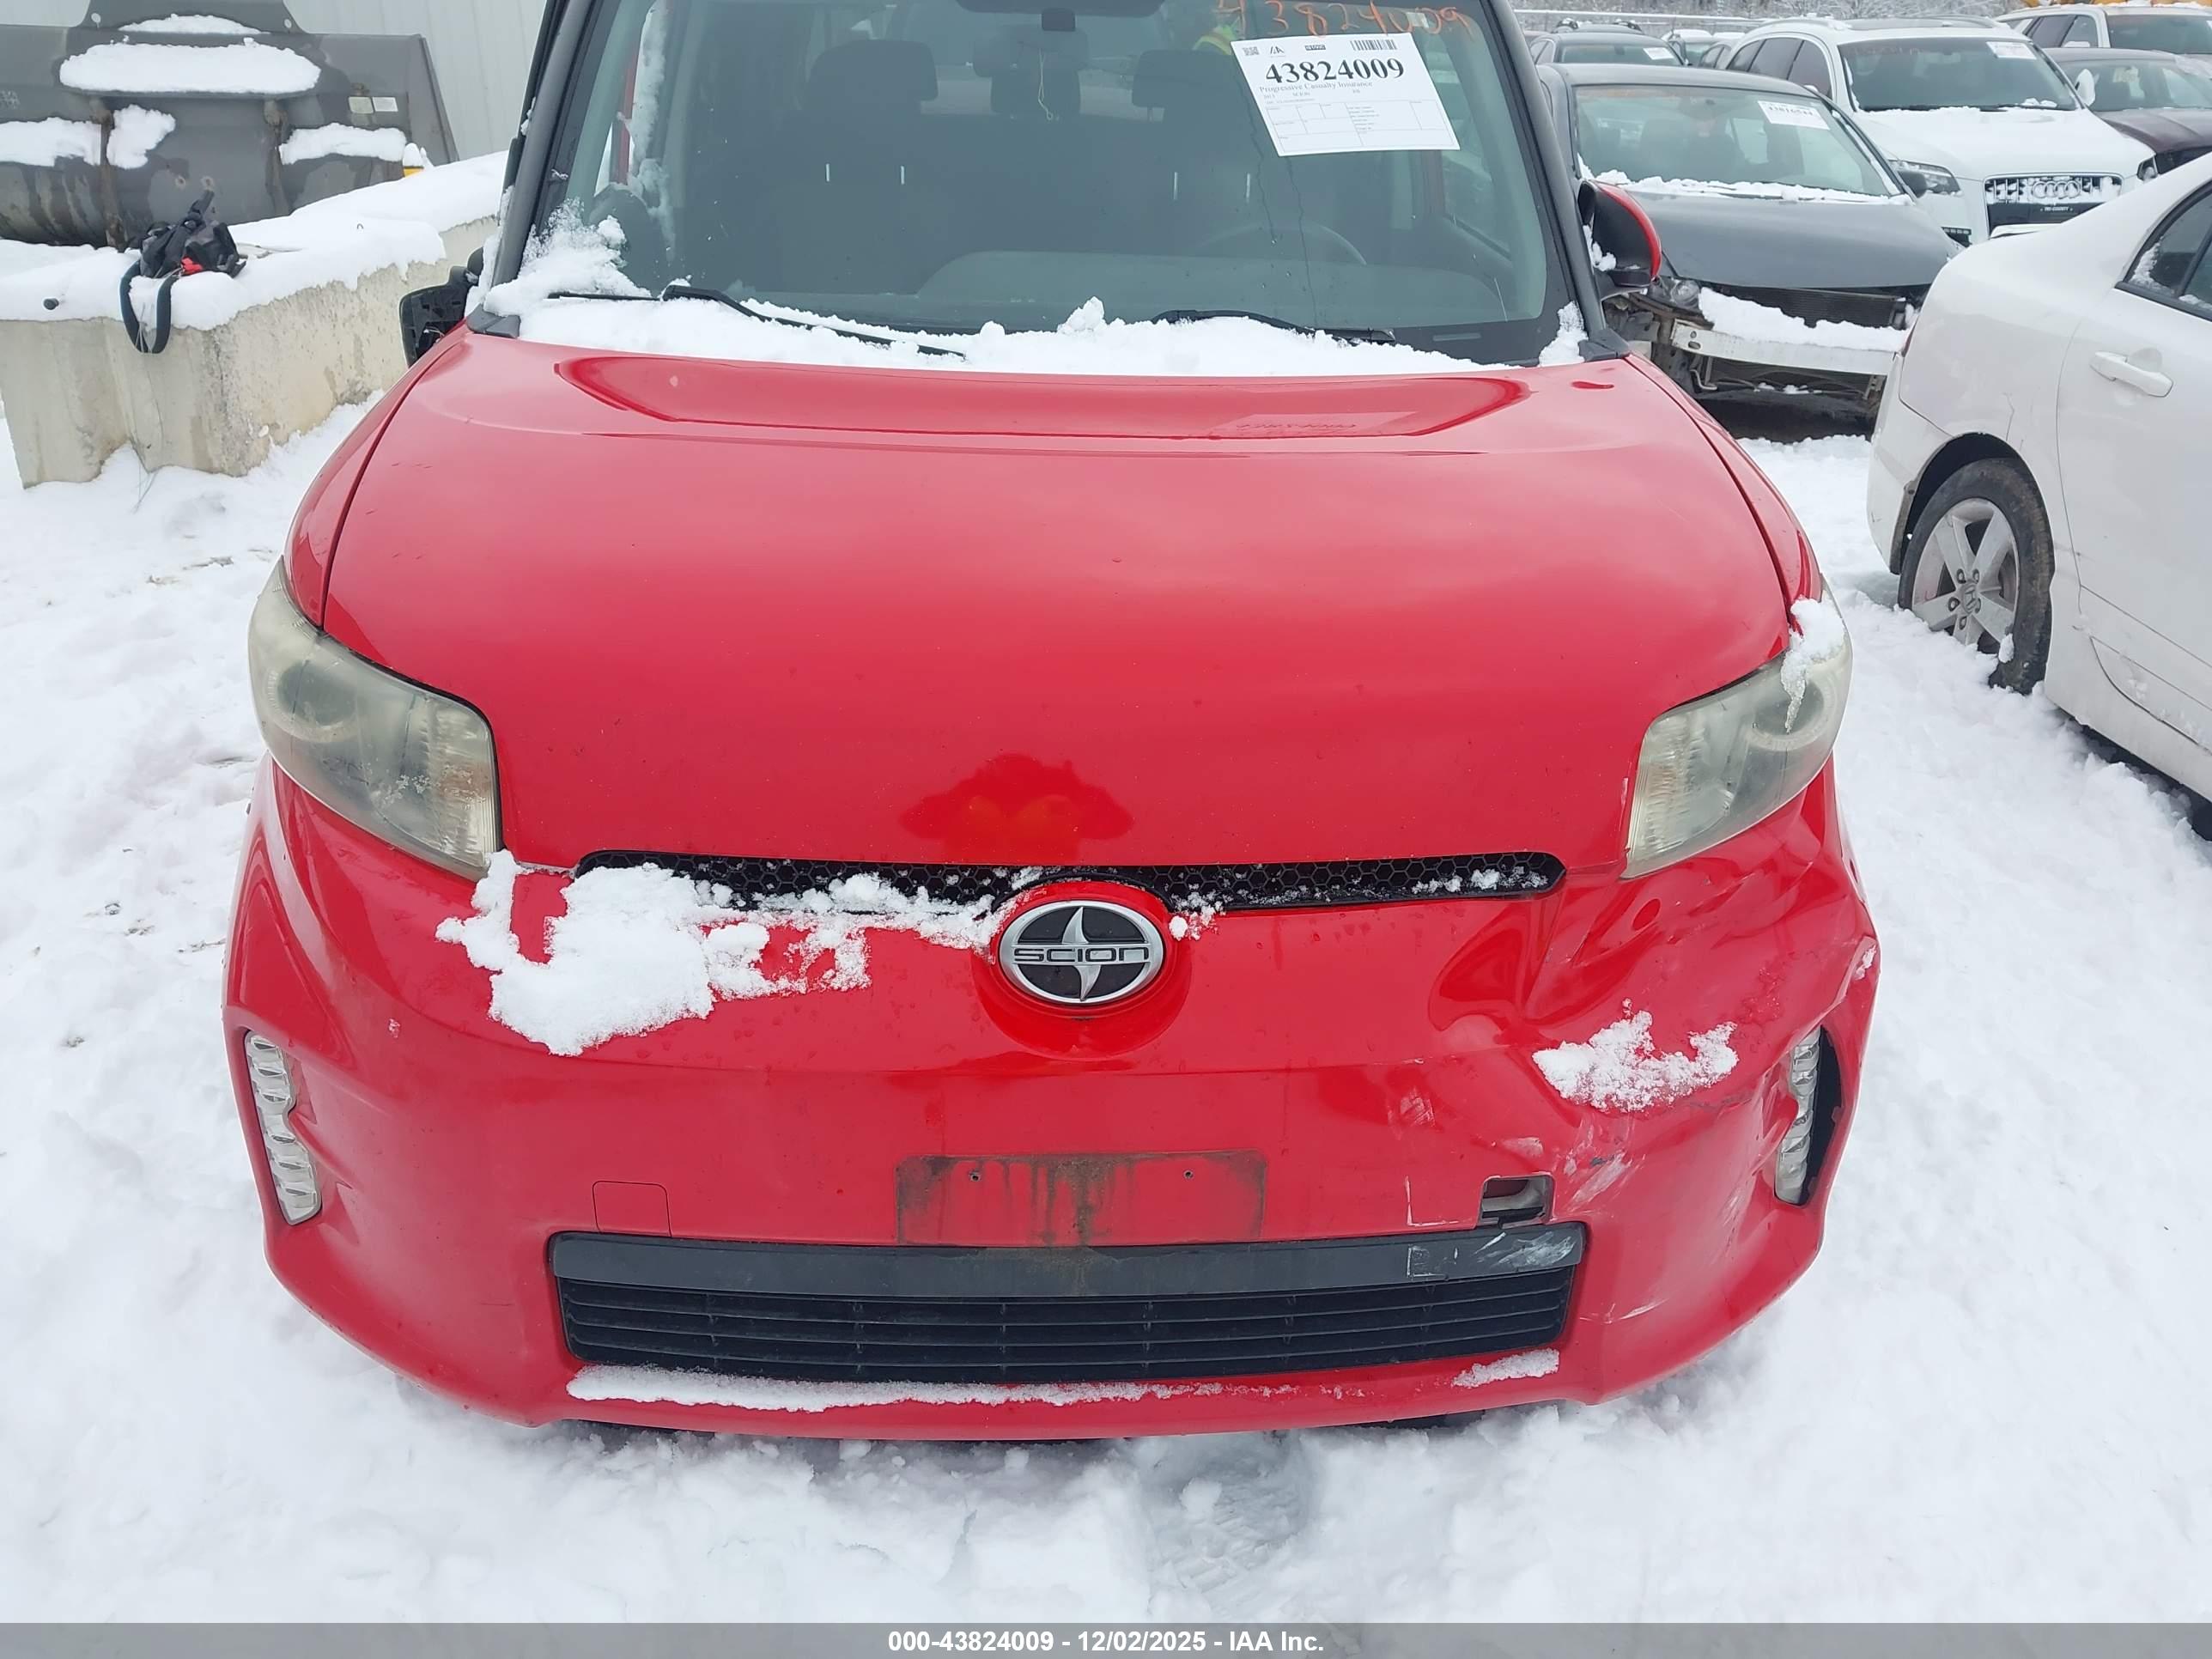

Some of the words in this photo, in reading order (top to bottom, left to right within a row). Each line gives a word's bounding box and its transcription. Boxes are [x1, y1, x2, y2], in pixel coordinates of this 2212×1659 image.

[1266, 58, 1404, 83] 43824009
[1259, 84, 1303, 94] Progressive
[1304, 82, 1336, 90] Casualty
[1338, 80, 1373, 88] Insurance
[1014, 946, 1149, 963] SCION
